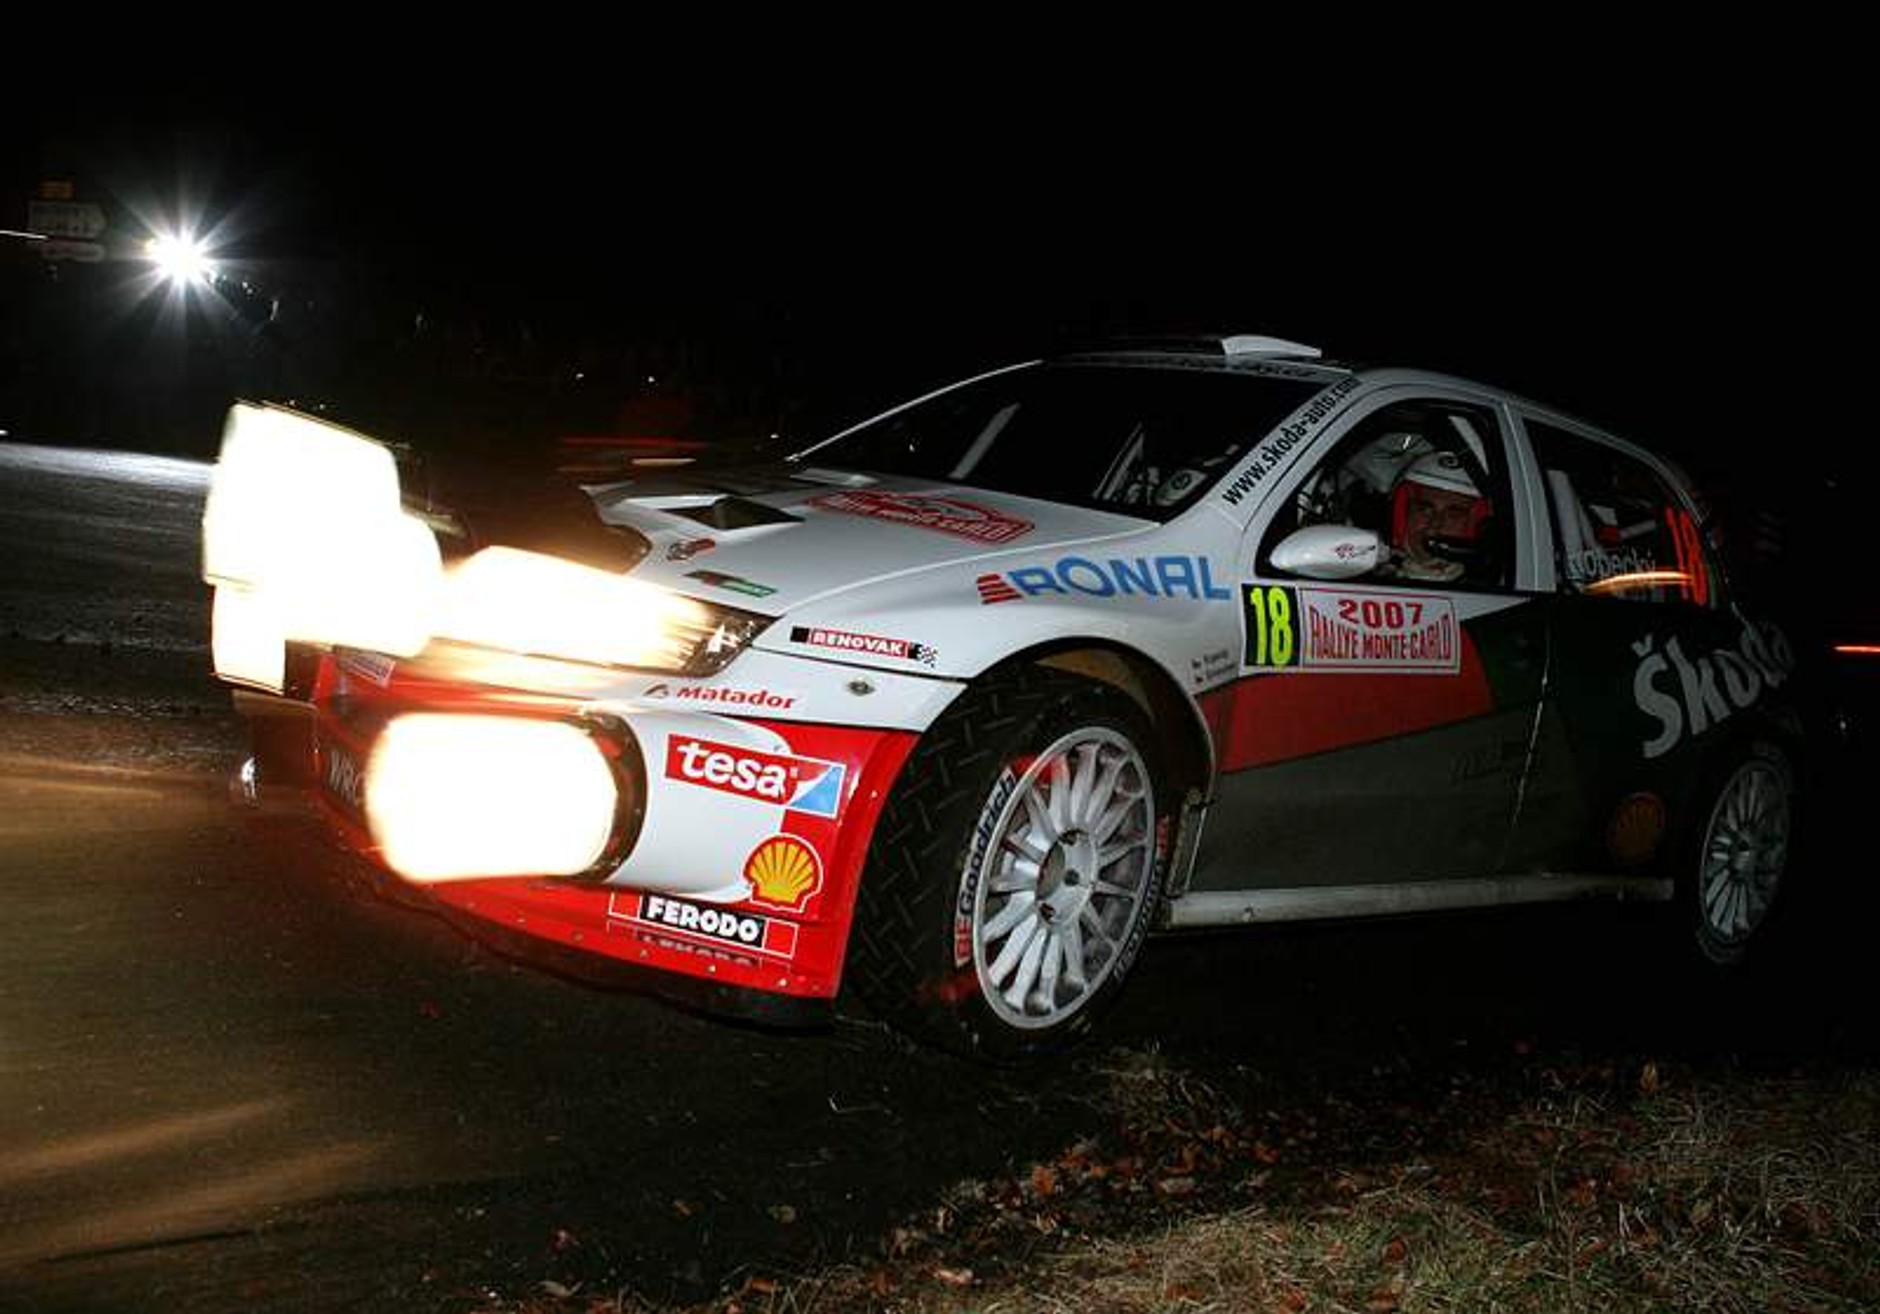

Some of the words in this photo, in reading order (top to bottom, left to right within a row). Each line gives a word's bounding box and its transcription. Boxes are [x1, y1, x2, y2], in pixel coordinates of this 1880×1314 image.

[1006, 556, 1232, 599] RONAL
[1250, 586, 1294, 667] 18
[1309, 604, 1360, 661] RALLYE
[1362, 632, 1410, 660] MONTE
[1409, 612, 1451, 660] CARLO
[1338, 599, 1423, 629] 2007
[812, 629, 903, 657] RENOVAK
[676, 685, 797, 710] Matador
[1630, 620, 1799, 760] Škoda
[677, 741, 788, 800] tesa
[648, 896, 761, 944] FERODO
